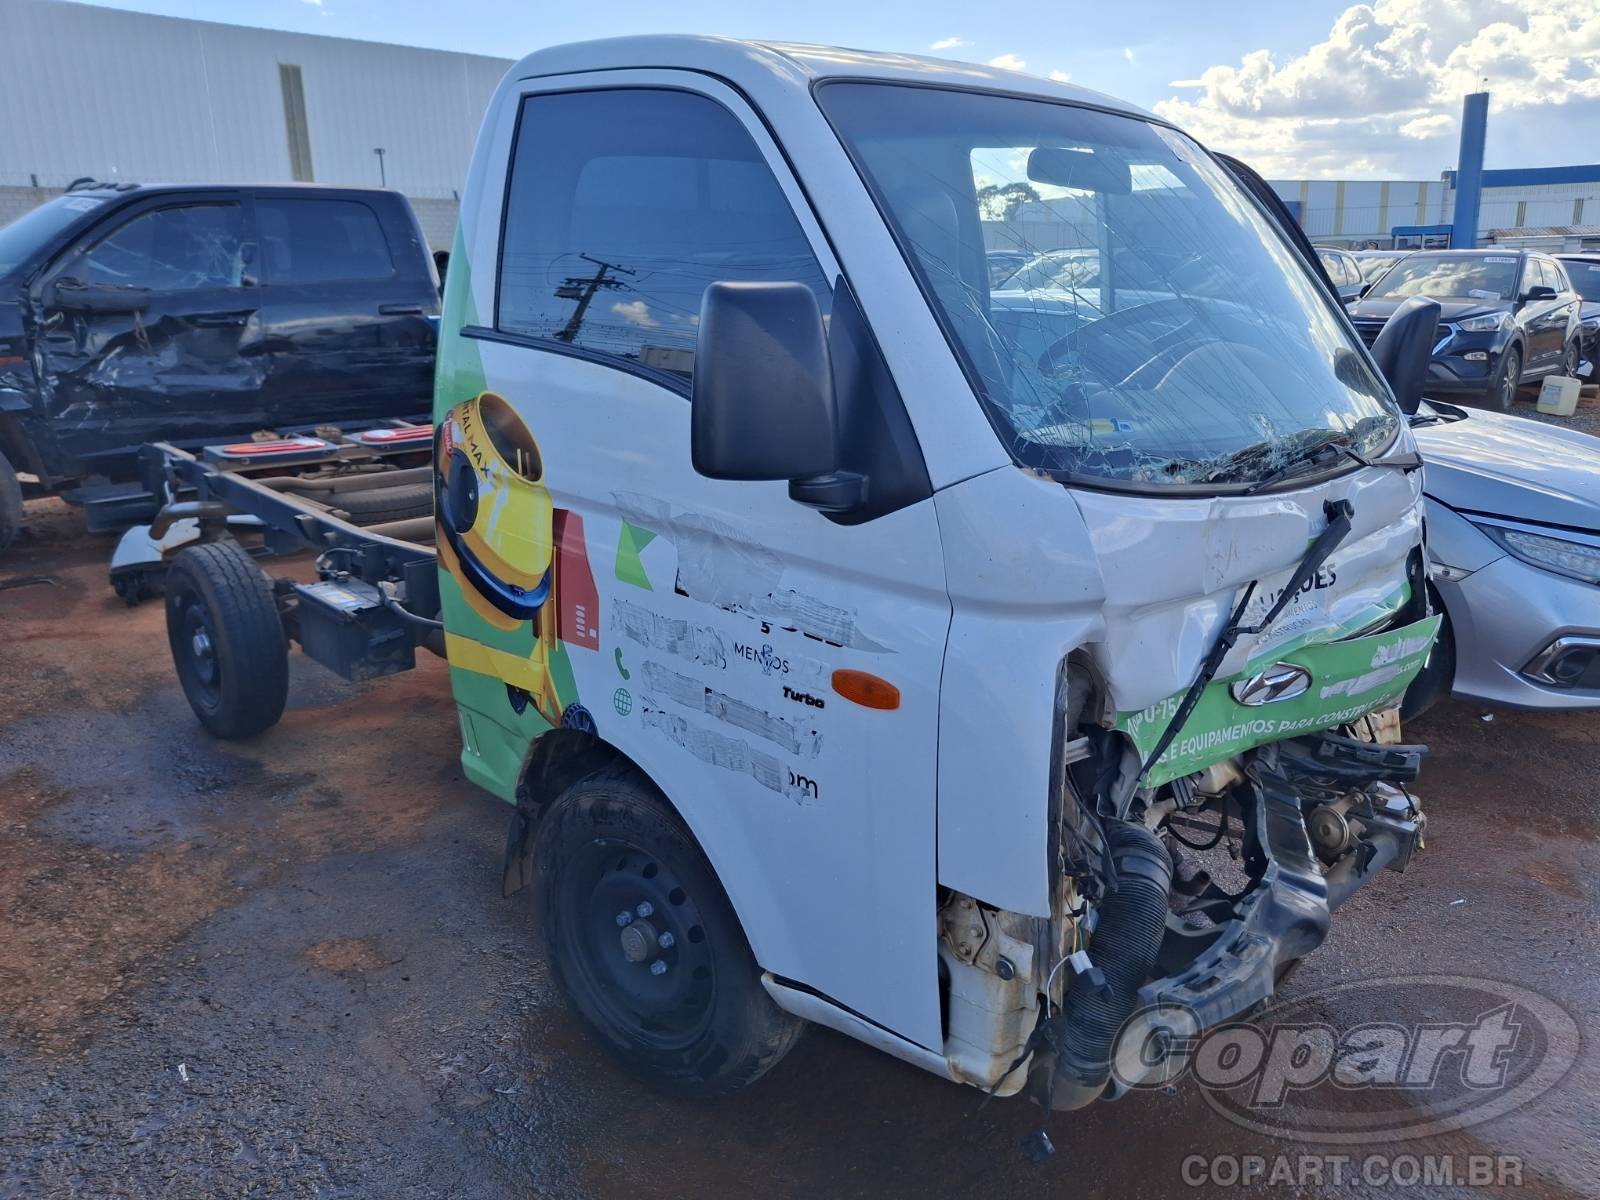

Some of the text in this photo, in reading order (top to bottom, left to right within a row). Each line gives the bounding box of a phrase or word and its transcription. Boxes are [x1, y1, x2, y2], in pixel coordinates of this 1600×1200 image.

[782, 686, 826, 709] Turbo
[1180, 719, 1277, 756] EQUIPAMENTOS
[1278, 715, 1314, 733] PARA
